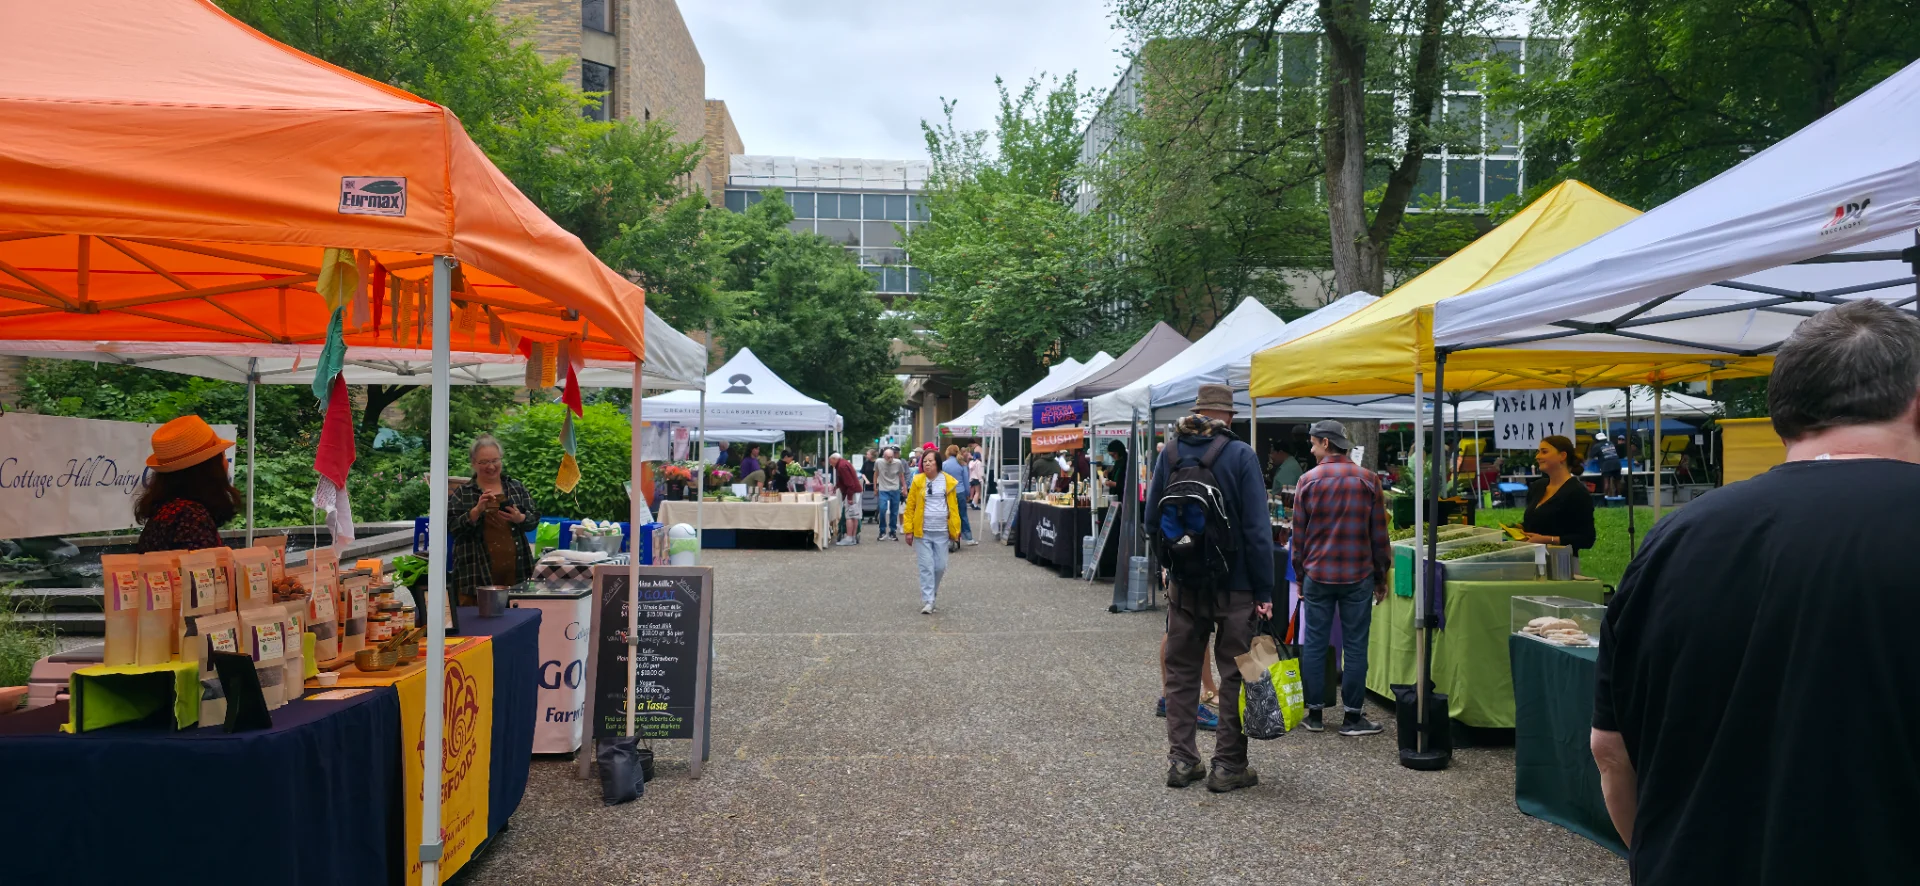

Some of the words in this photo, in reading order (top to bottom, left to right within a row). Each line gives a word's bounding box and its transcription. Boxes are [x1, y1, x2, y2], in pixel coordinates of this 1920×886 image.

[342, 191, 399, 209] Eurmax
[1041, 414, 1077, 424] ELIXIRS
[1036, 434, 1079, 446] SLUSHY
[0, 457, 54, 498] Cottage
[57, 455, 105, 488] Hill
[96, 458, 141, 494] Dairy
[653, 580, 674, 588] Milk?
[652, 655, 679, 663] Strawberry
[646, 700, 668, 711] Taste
